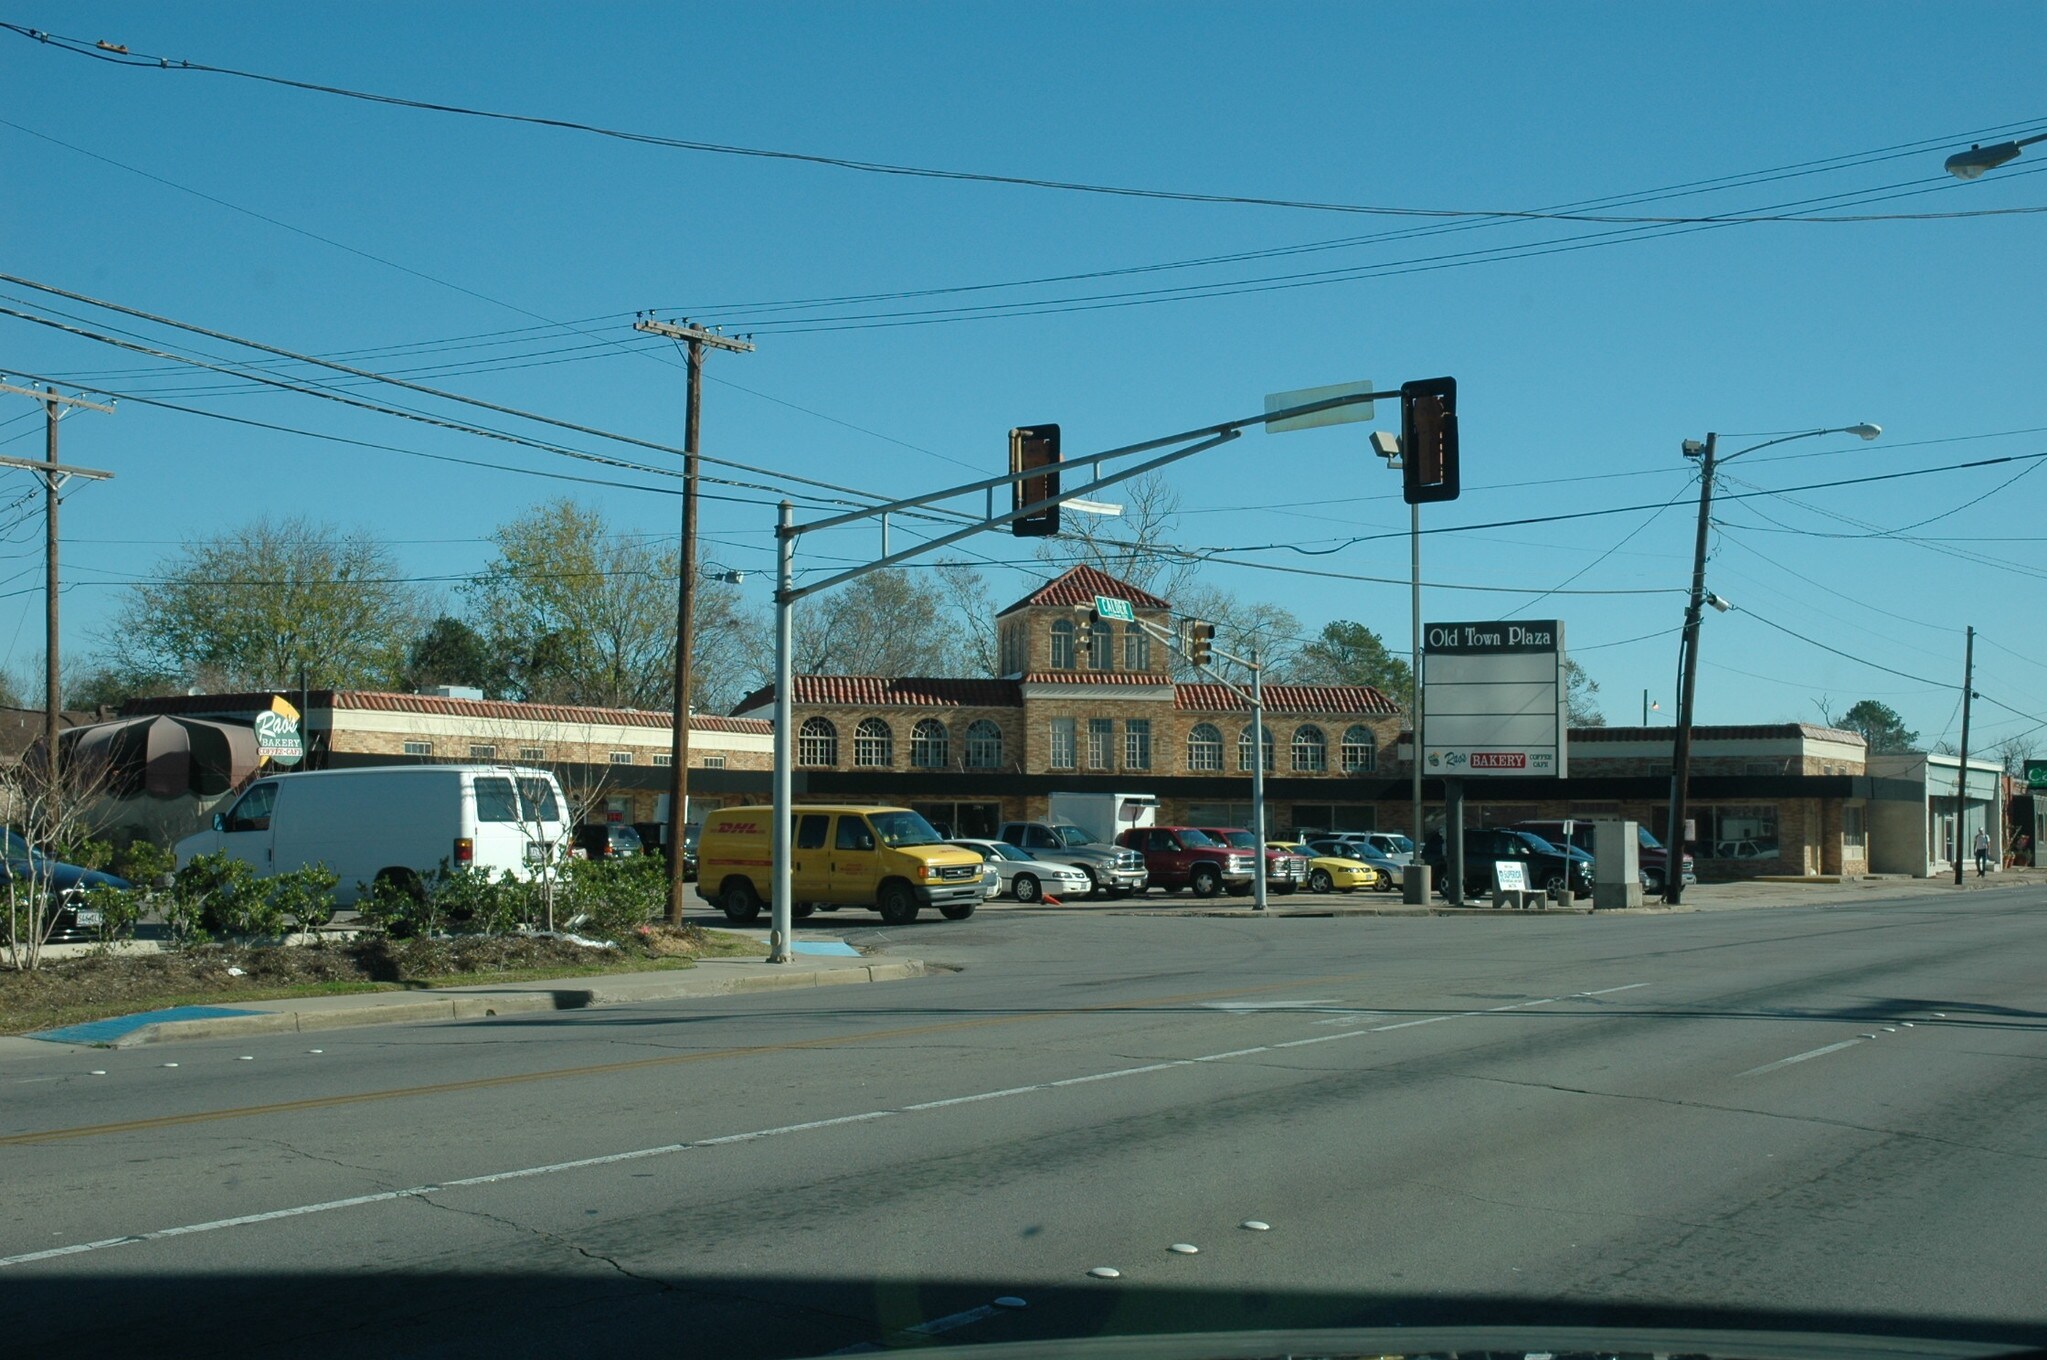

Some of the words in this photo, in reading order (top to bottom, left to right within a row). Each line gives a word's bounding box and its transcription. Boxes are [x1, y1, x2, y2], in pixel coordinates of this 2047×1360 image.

[1429, 628, 1458, 647] Old
[1465, 627, 1501, 646] Town
[1508, 626, 1551, 645] Plaza
[256, 710, 298, 742] Rao's
[262, 738, 300, 747] BAKERY
[1472, 754, 1524, 767] BAKERY
[1529, 753, 1553, 761] COFFEE
[719, 822, 757, 834] DHL
